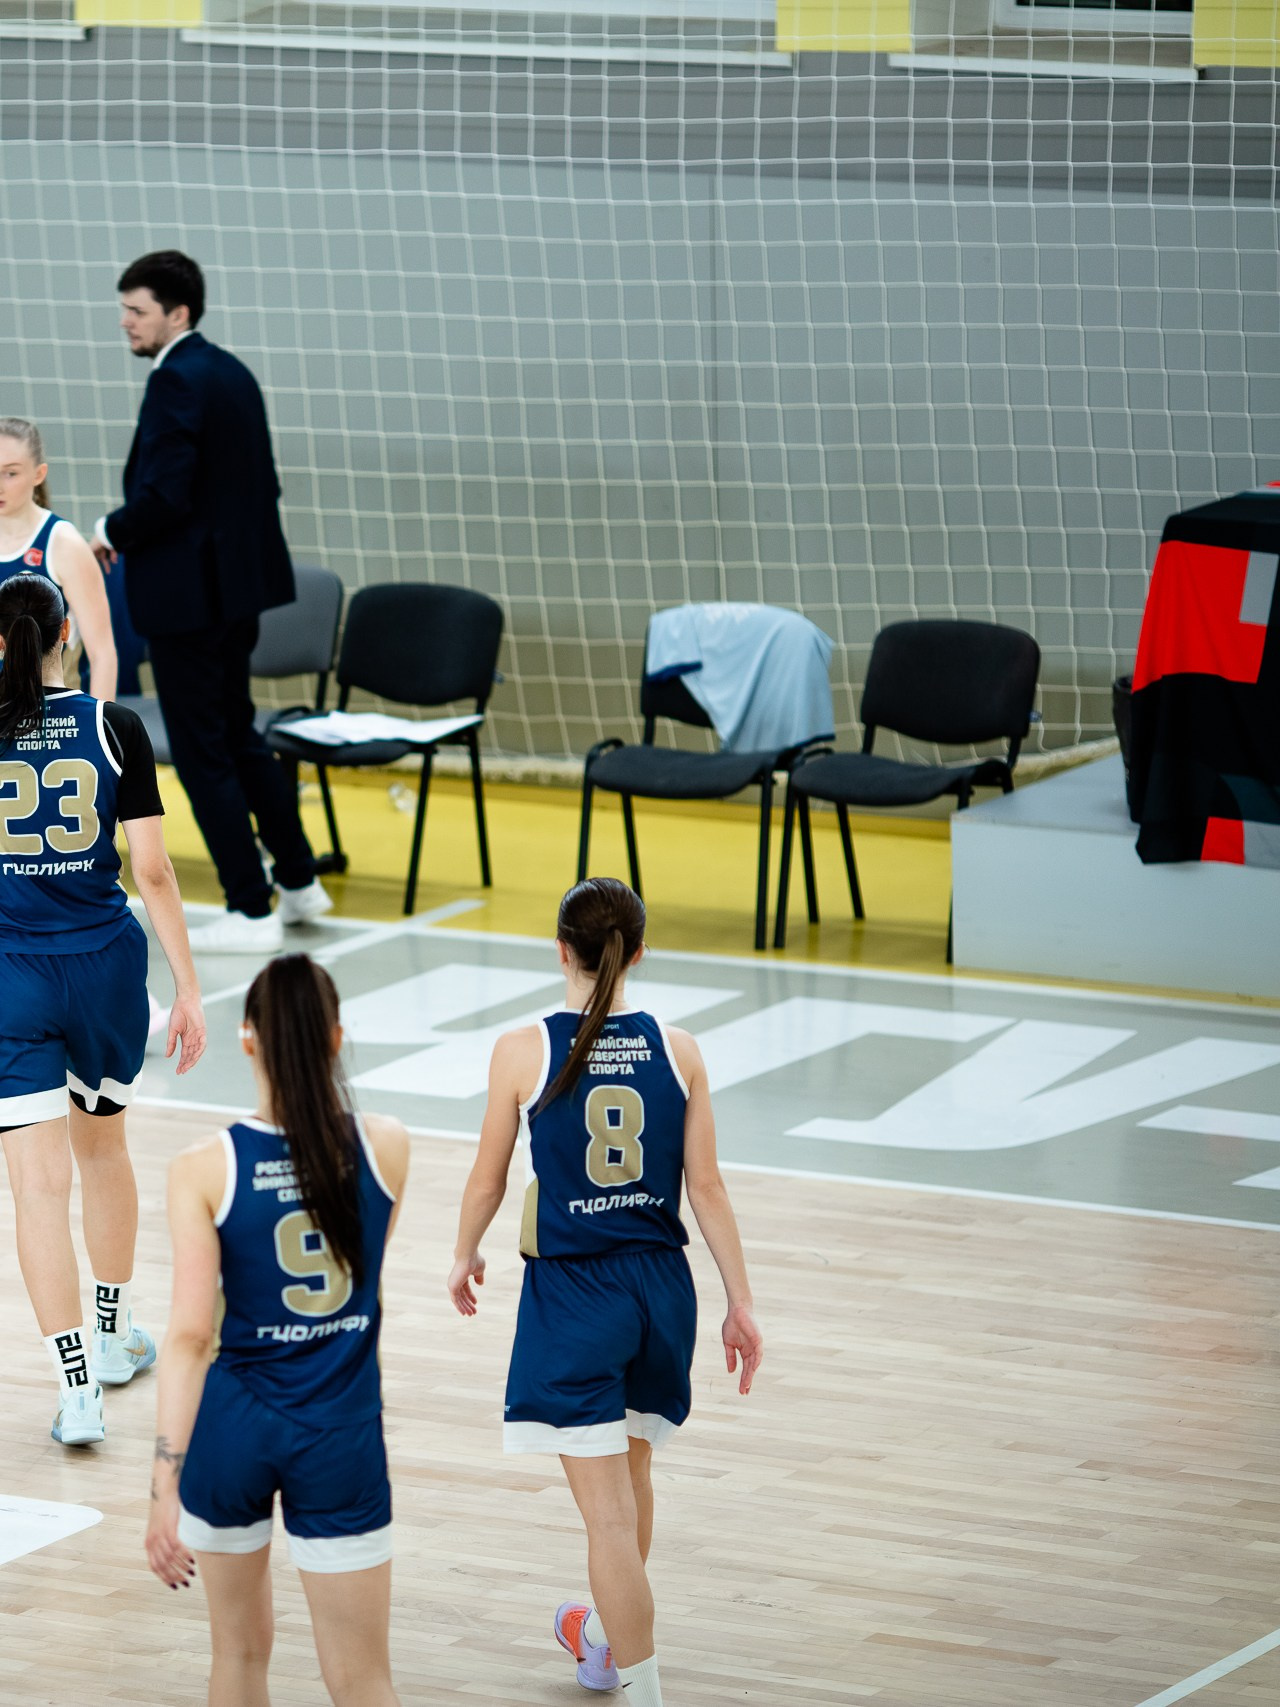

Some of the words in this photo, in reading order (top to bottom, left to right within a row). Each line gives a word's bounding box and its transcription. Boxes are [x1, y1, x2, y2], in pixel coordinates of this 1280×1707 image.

[2, 858, 96, 876] ГЦОЛИФК
[588, 1063, 635, 1075] СПОРТА
[585, 1084, 645, 1188] 8
[273, 1209, 353, 1318] 9
[54, 1332, 89, 1388] ELITE
